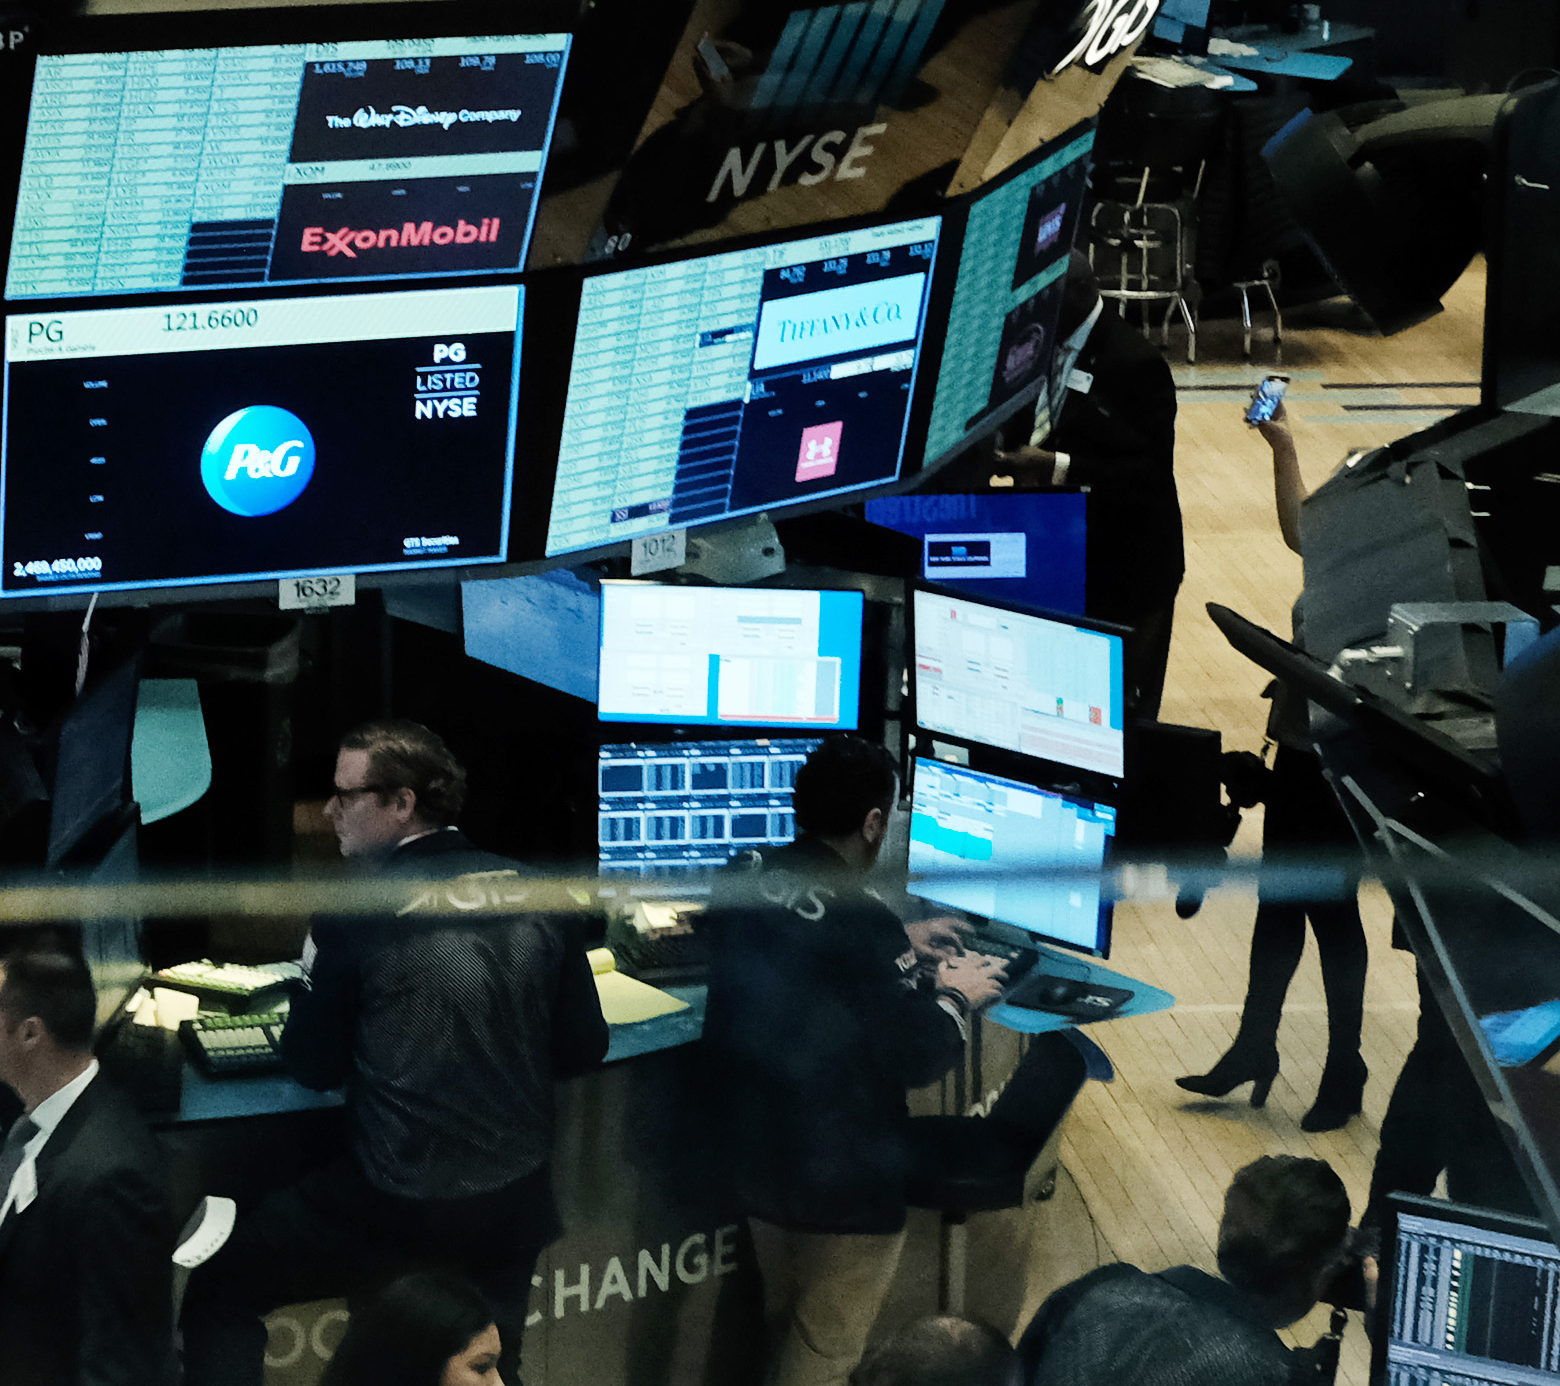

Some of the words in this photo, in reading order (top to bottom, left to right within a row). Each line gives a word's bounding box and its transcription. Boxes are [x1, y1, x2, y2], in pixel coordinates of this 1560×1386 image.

[706, 122, 888, 203] NYSE
[300, 218, 500, 257] ExxonMobil
[26, 321, 64, 344] PG
[161, 308, 258, 332] 121.6600
[432, 343, 466, 363] PG
[416, 372, 479, 391] LISTED
[416, 398, 477, 419] NYSE
[224, 440, 304, 481] P&G
[639, 535, 677, 558] 1012
[293, 578, 341, 598] 1632
[524, 1223, 740, 1328] HANGE
